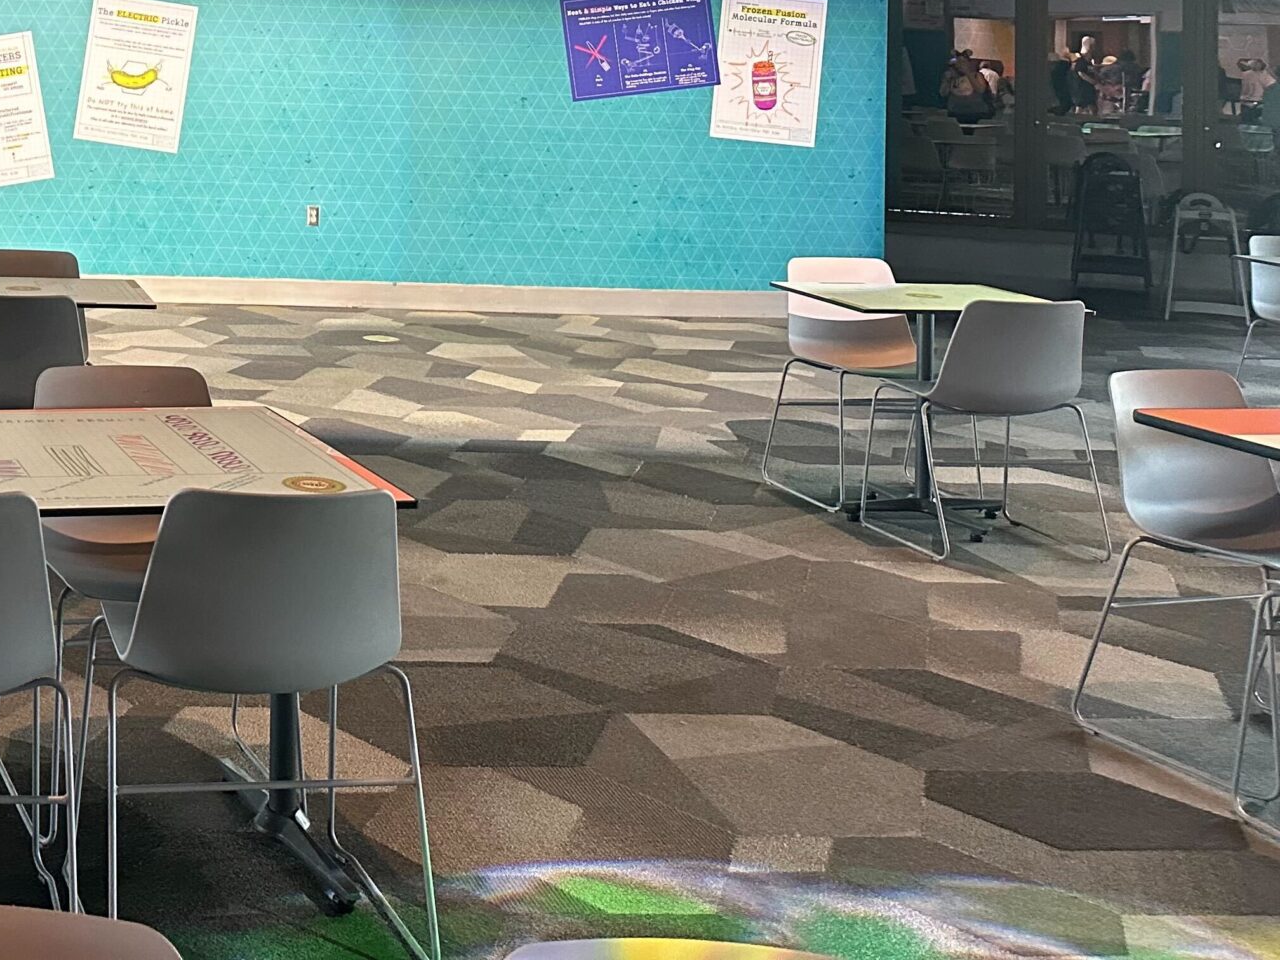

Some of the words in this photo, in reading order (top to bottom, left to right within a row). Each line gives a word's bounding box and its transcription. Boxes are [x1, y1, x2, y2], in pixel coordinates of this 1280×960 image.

[98, 7, 114, 16] The
[116, 10, 159, 23] ELECTRIC
[161, 18, 189, 28] Pickle
[741, 5, 772, 15] Frozen
[776, 9, 806, 19] Fusion
[731, 13, 777, 24] Molecular
[780, 18, 817, 28] Formula
